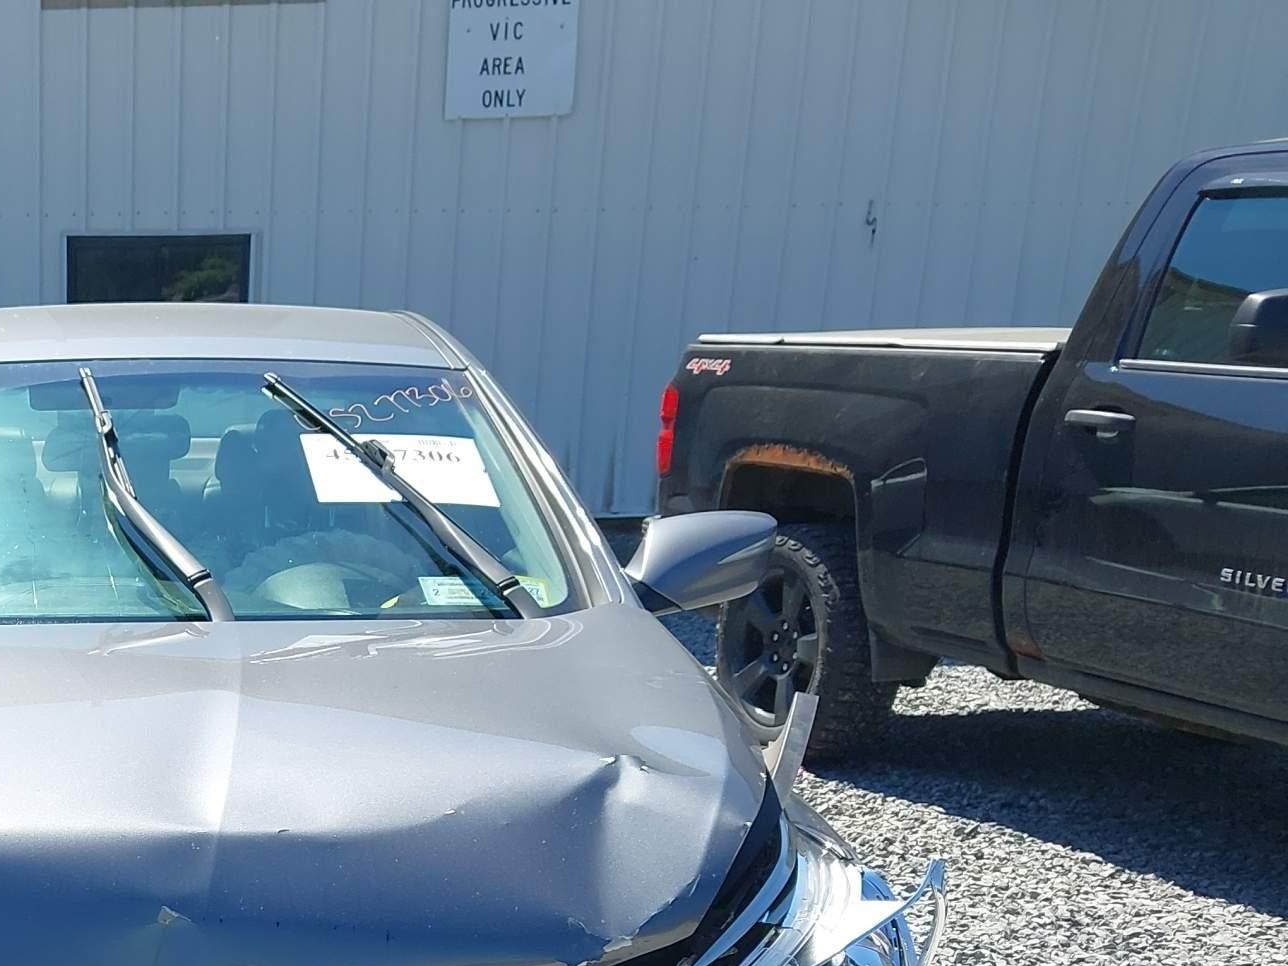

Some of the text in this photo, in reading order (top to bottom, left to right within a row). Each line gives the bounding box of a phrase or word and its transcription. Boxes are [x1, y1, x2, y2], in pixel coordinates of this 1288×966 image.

[490, 21, 524, 41] VIC
[479, 56, 525, 76] AREA
[481, 89, 526, 109] ONLY
[325, 448, 462, 464] 47306
[1219, 567, 1288, 593] SILVE
